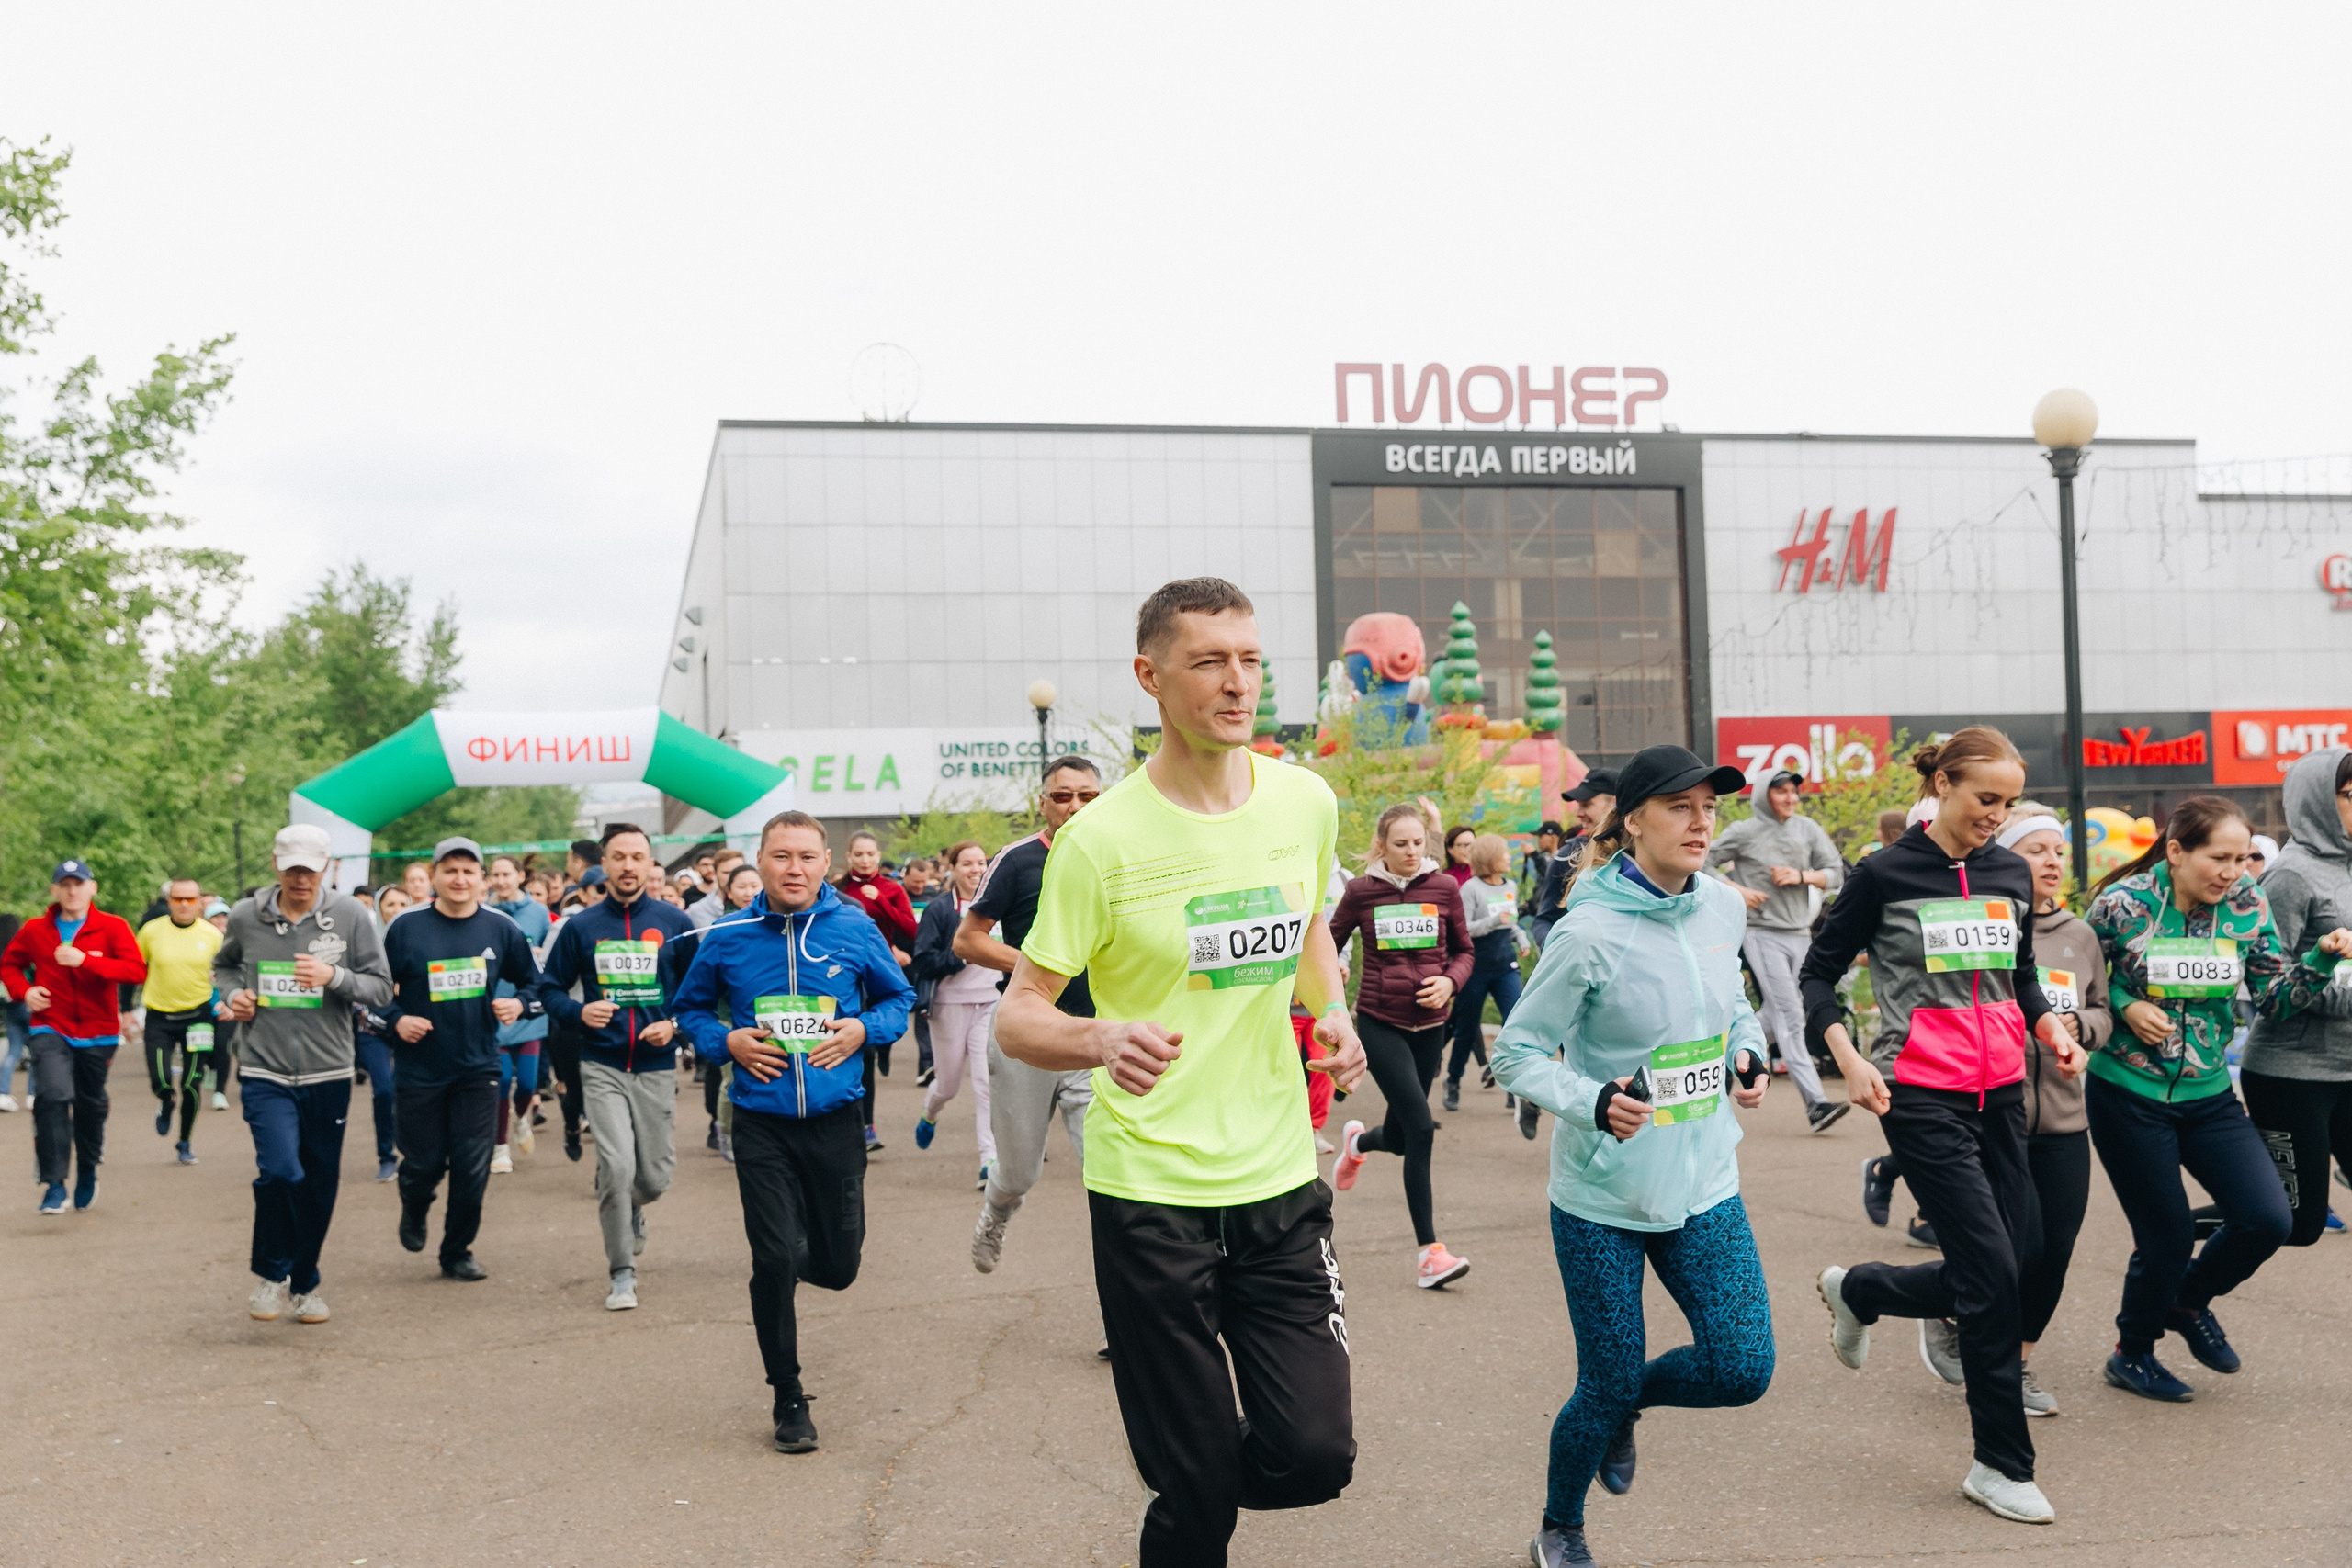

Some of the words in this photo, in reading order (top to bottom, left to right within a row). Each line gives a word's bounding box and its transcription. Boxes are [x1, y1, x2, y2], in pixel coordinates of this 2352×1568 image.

[1335, 362, 1668, 425] ПИОНЕР
[1385, 444, 1502, 477] ВСЕГДА
[1511, 438, 1637, 475] ПЕРВЫЙ
[1776, 507, 1897, 594] H&M
[468, 736, 630, 763] ФИНИШ
[940, 742, 1009, 758] UNITED
[1015, 740, 1089, 757] COLORS
[941, 762, 964, 778] OF
[971, 761, 1050, 778] BENETT
[1396, 919, 1434, 933] 0346
[1229, 919, 1302, 959] 0207
[1955, 926, 2010, 947] 0159
[615, 957, 651, 970] 0037
[1234, 966, 1273, 978] бежим
[2177, 962, 2232, 980] 0083
[448, 974, 481, 987] 0212
[781, 1018, 829, 1034] 0624
[1685, 1062, 1724, 1095] 059
